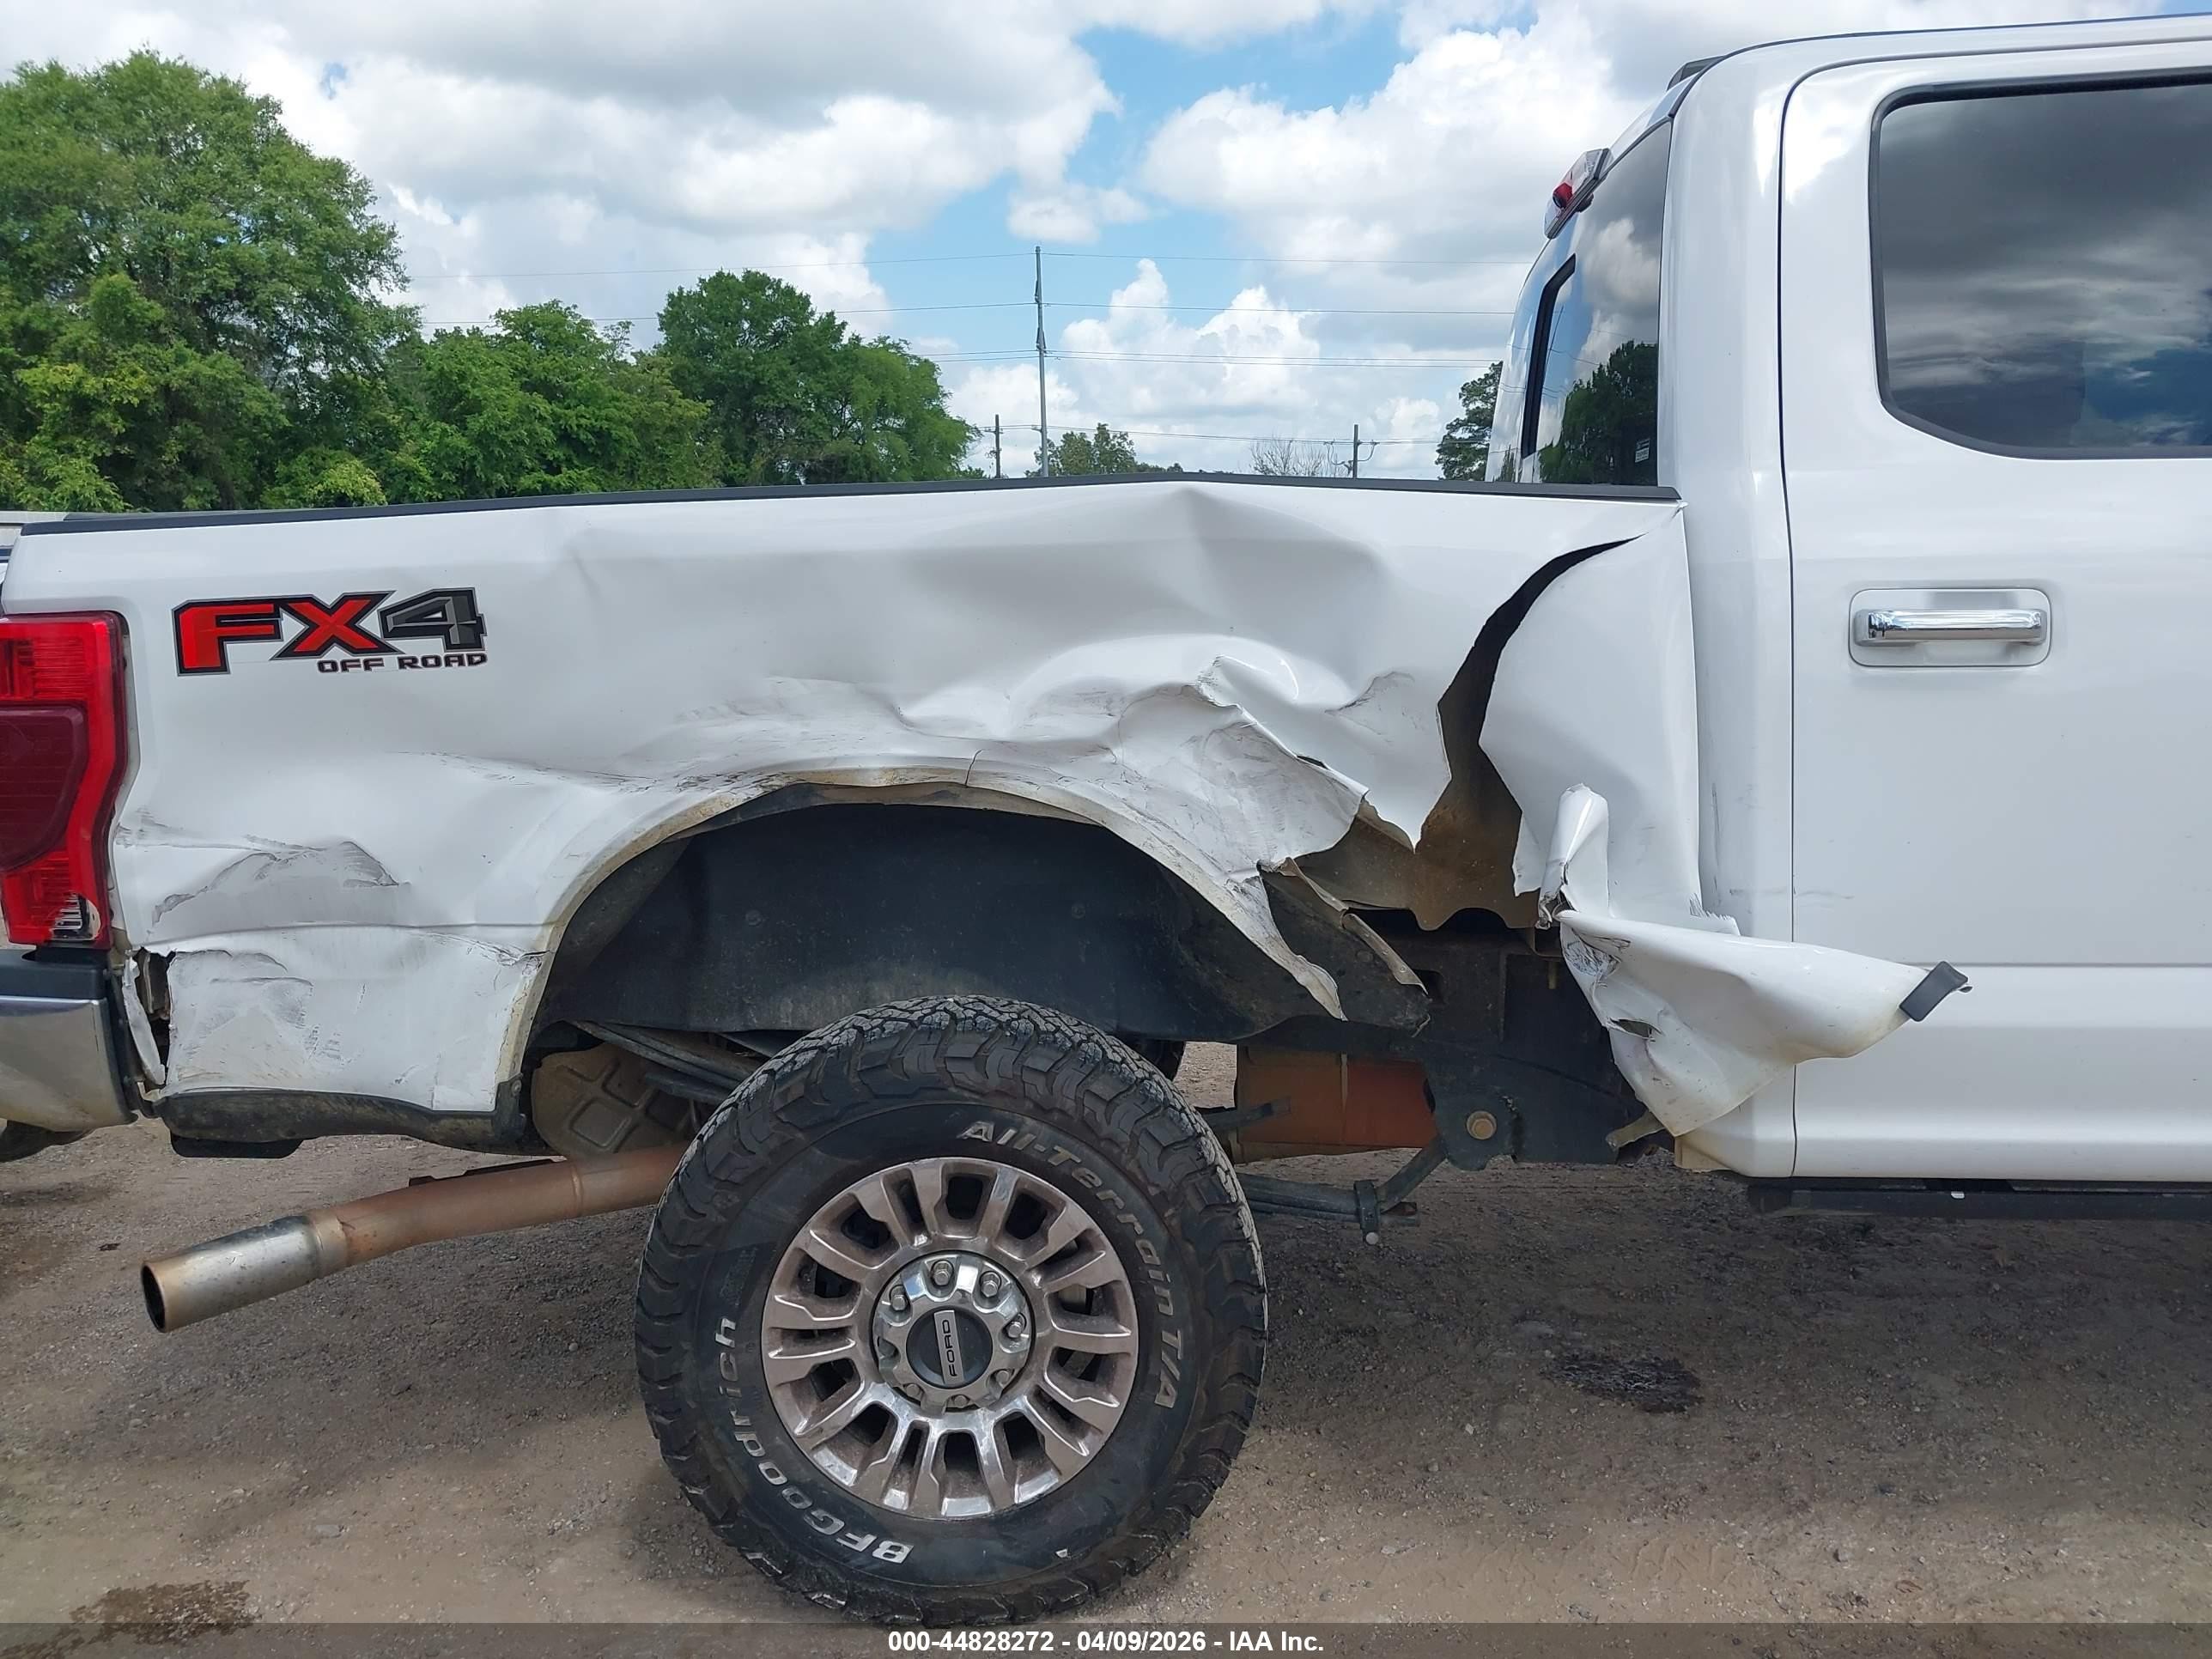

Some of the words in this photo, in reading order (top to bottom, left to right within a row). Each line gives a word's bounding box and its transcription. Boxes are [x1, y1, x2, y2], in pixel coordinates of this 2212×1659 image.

[172, 587, 487, 676] FX4
[317, 658, 386, 674] OFF
[397, 653, 489, 671] ROAD
[957, 1120, 1174, 1316] All-Terrain
[1154, 1329, 1183, 1409] T/A
[941, 1319, 958, 1376] FORD
[714, 1317, 915, 1565] BFGoodrich
